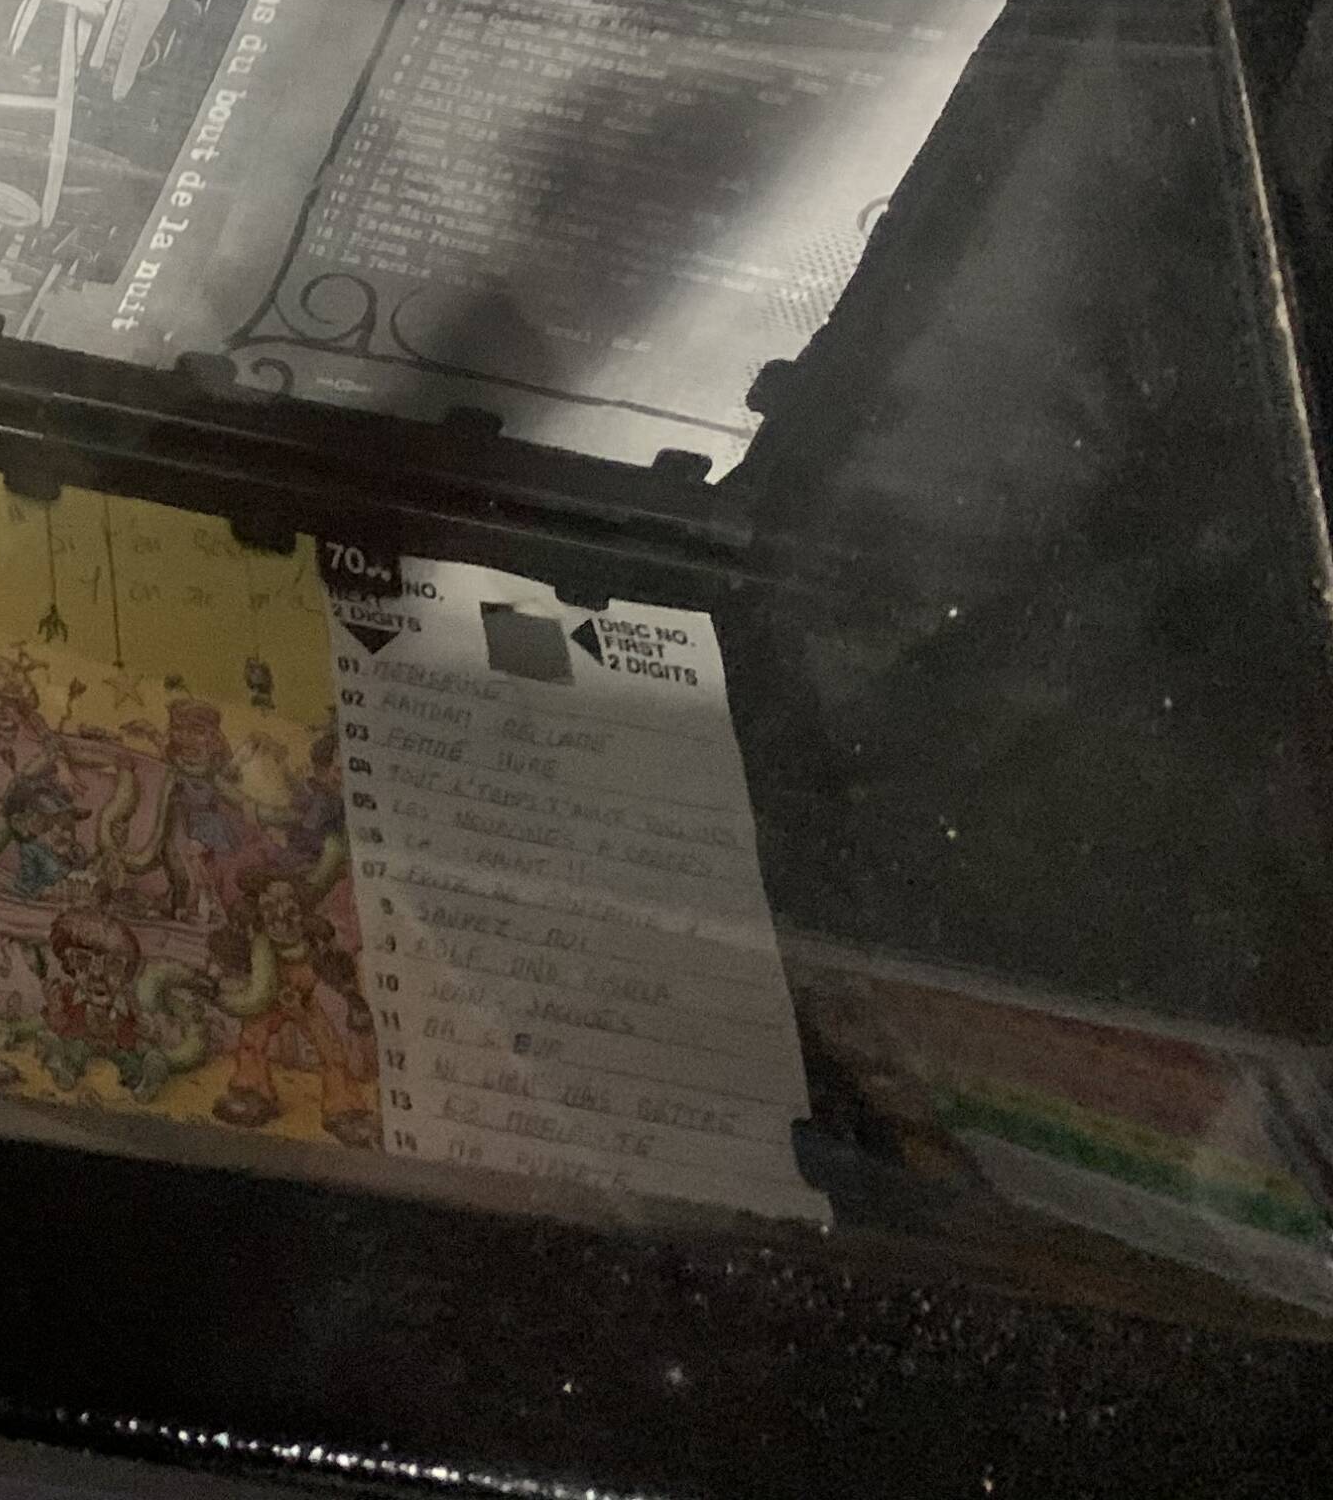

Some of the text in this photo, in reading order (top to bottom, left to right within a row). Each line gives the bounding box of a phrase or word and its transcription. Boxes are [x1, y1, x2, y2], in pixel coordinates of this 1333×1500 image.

[227, 32, 268, 74] du
[189, 88, 248, 164] bout
[170, 169, 206, 210] de
[149, 215, 190, 252] la
[110, 258, 162, 333] nuit
[326, 541, 366, 575] 70
[401, 581, 445, 601] NO.
[351, 608, 421, 632] DIGITS
[599, 617, 697, 648] DISC NO.
[604, 638, 666, 659] FIRST
[338, 656, 360, 675] 01
[609, 657, 698, 686] 2 DIGITS
[341, 687, 365, 708] 02
[345, 722, 370, 742] 03
[375, 971, 400, 993] 10
